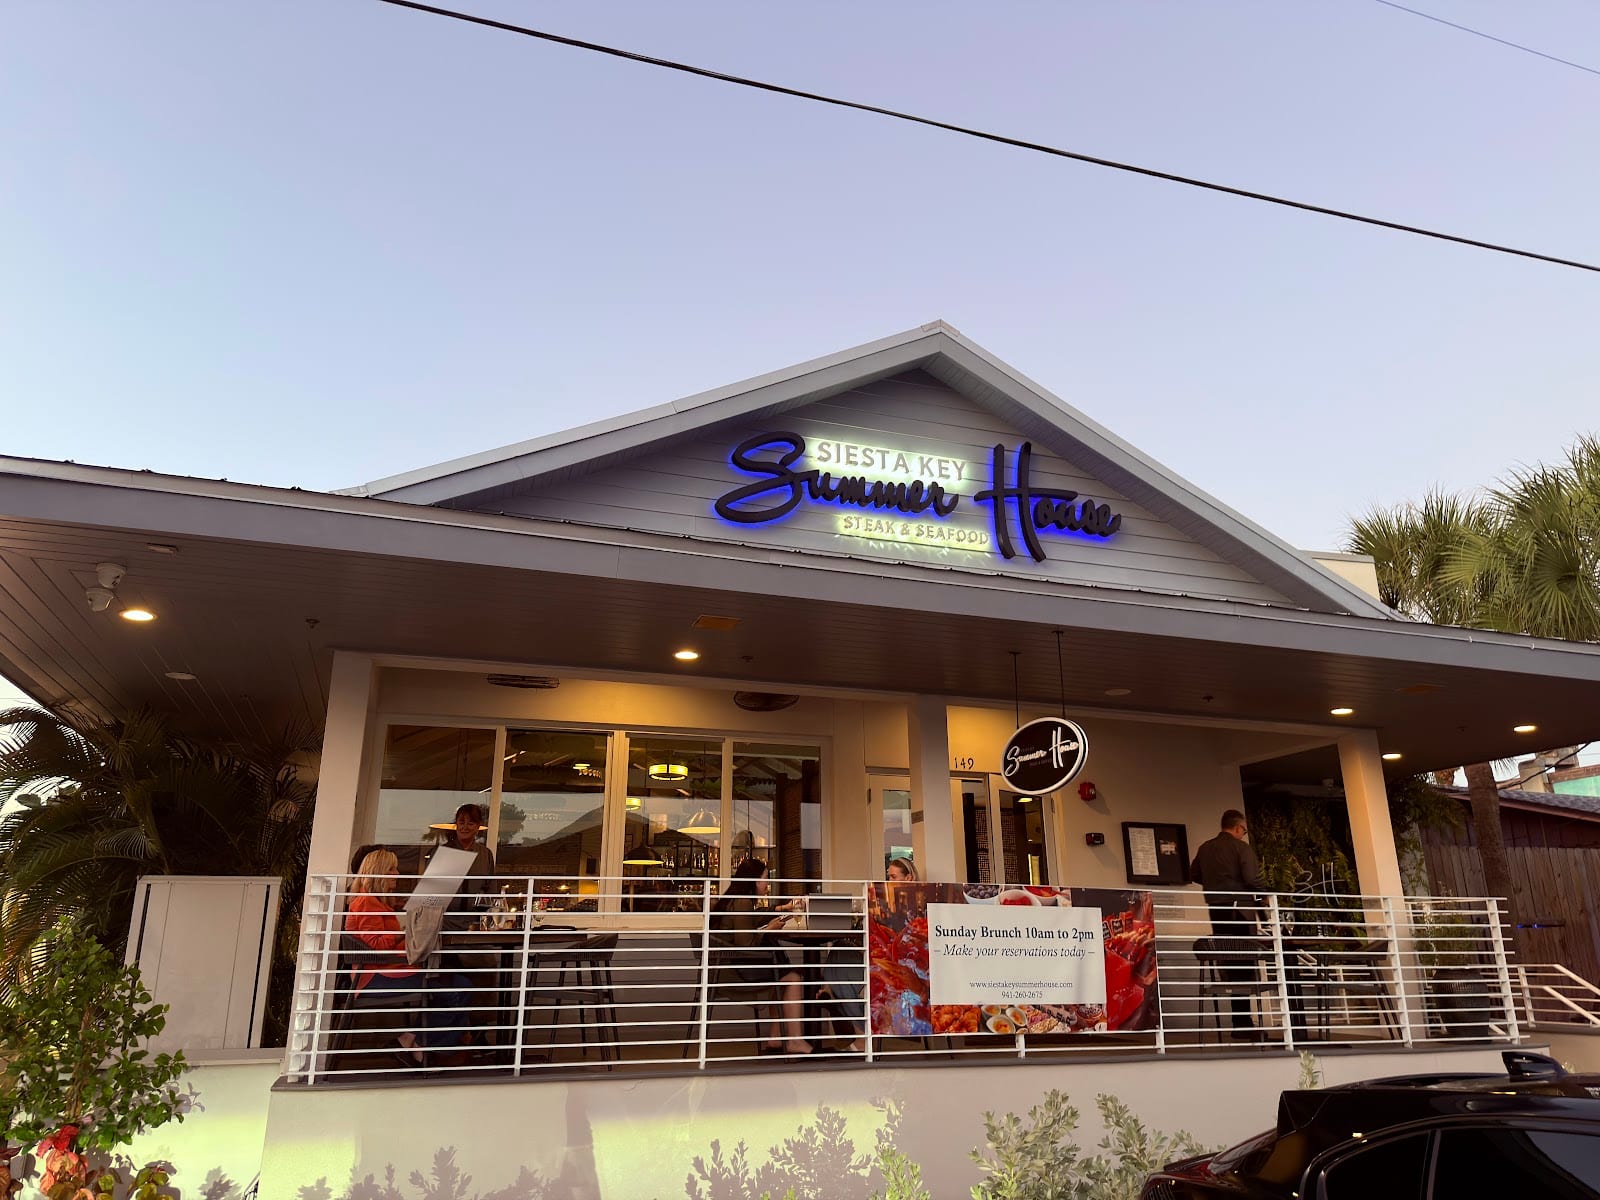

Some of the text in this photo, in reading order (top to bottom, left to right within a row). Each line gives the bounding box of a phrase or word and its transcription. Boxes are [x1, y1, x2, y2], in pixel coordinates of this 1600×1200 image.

[817, 441, 967, 481] SIESTA KEY
[714, 431, 1122, 562] Summer House
[843, 515, 989, 545] STEAK & SEAFOOD
[954, 757, 974, 770] 149
[935, 924, 977, 940] Sunday
[980, 926, 1021, 938] Brunch
[1025, 926, 1054, 939] 10am
[1057, 930, 1069, 939] to
[1072, 927, 1095, 942] 2pm
[943, 944, 973, 956] Make
[975, 947, 999, 959] your
[1001, 946, 1058, 957] reservations
[1060, 946, 1085, 960] today
[1001, 991, 1043, 999] 941-260-2675
